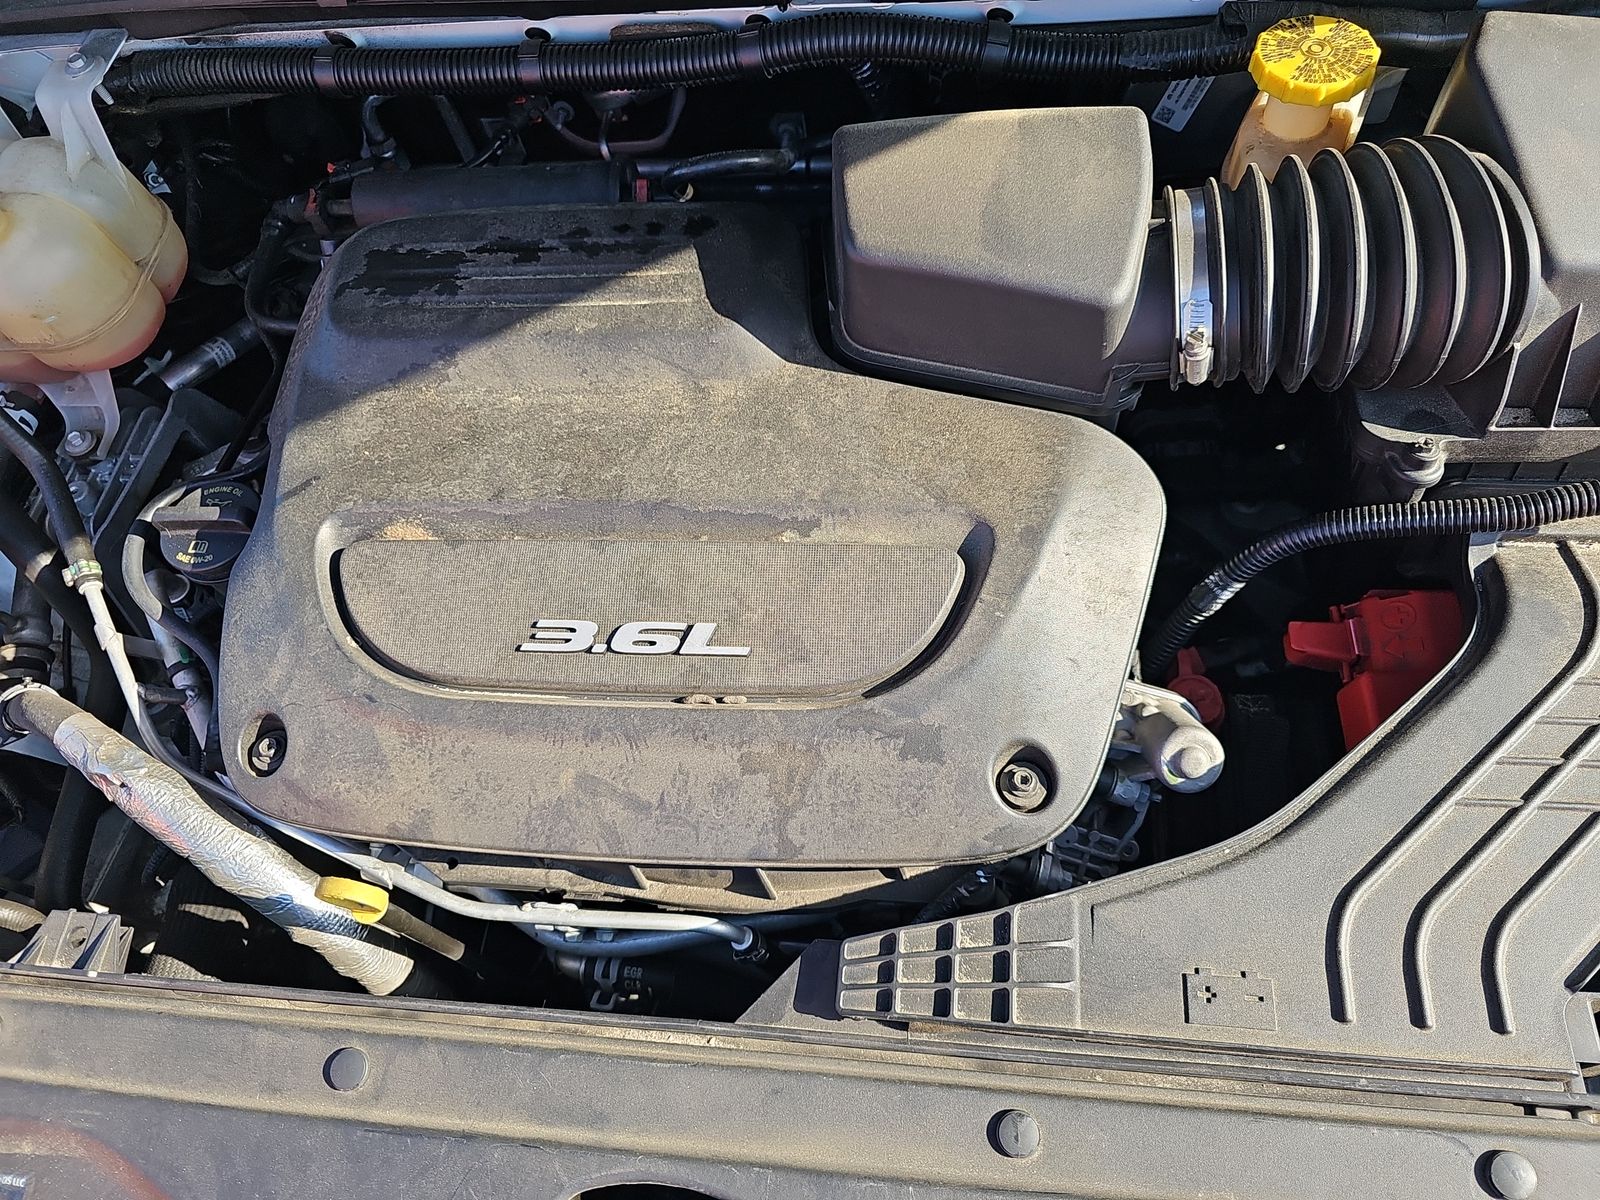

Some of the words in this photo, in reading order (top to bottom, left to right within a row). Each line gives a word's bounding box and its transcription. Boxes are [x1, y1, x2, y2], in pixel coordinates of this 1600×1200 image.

[203, 486, 233, 496] ENGINE
[232, 487, 244, 497] OIL
[175, 551, 191, 563] SAE
[516, 618, 751, 658] 3.6L
[623, 965, 644, 979] EGR
